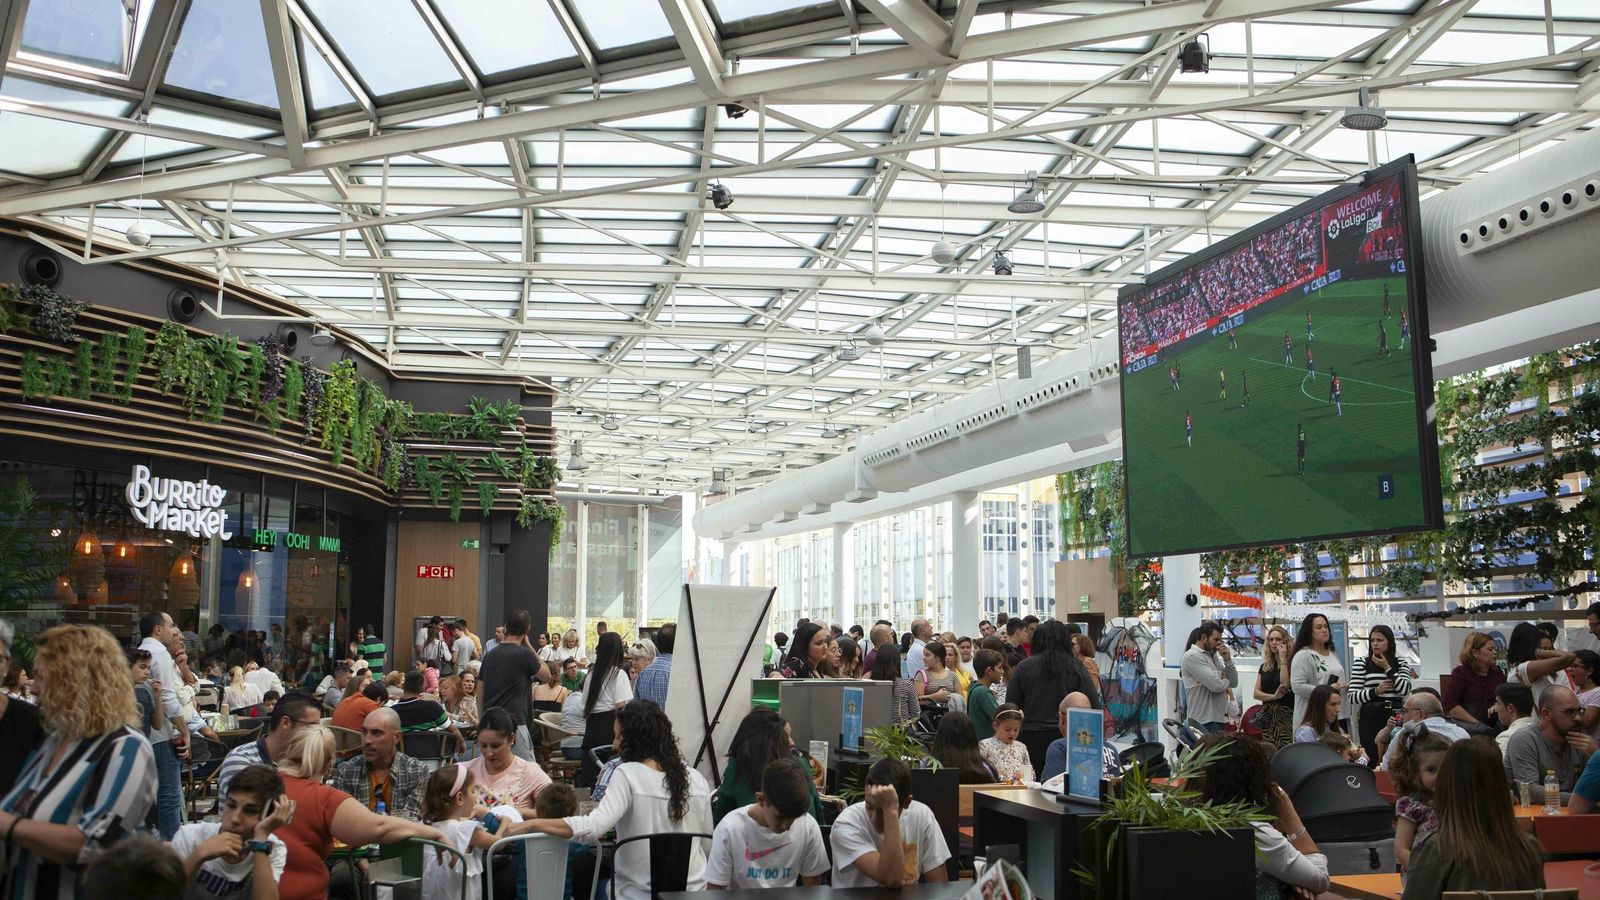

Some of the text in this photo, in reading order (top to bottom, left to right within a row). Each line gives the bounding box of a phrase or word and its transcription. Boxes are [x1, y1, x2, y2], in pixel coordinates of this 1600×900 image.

[1336, 189, 1382, 219] WELCOME
[255, 529, 277, 546] HEY!
[286, 533, 310, 550] OOH!
[764, 867, 779, 880] DO
